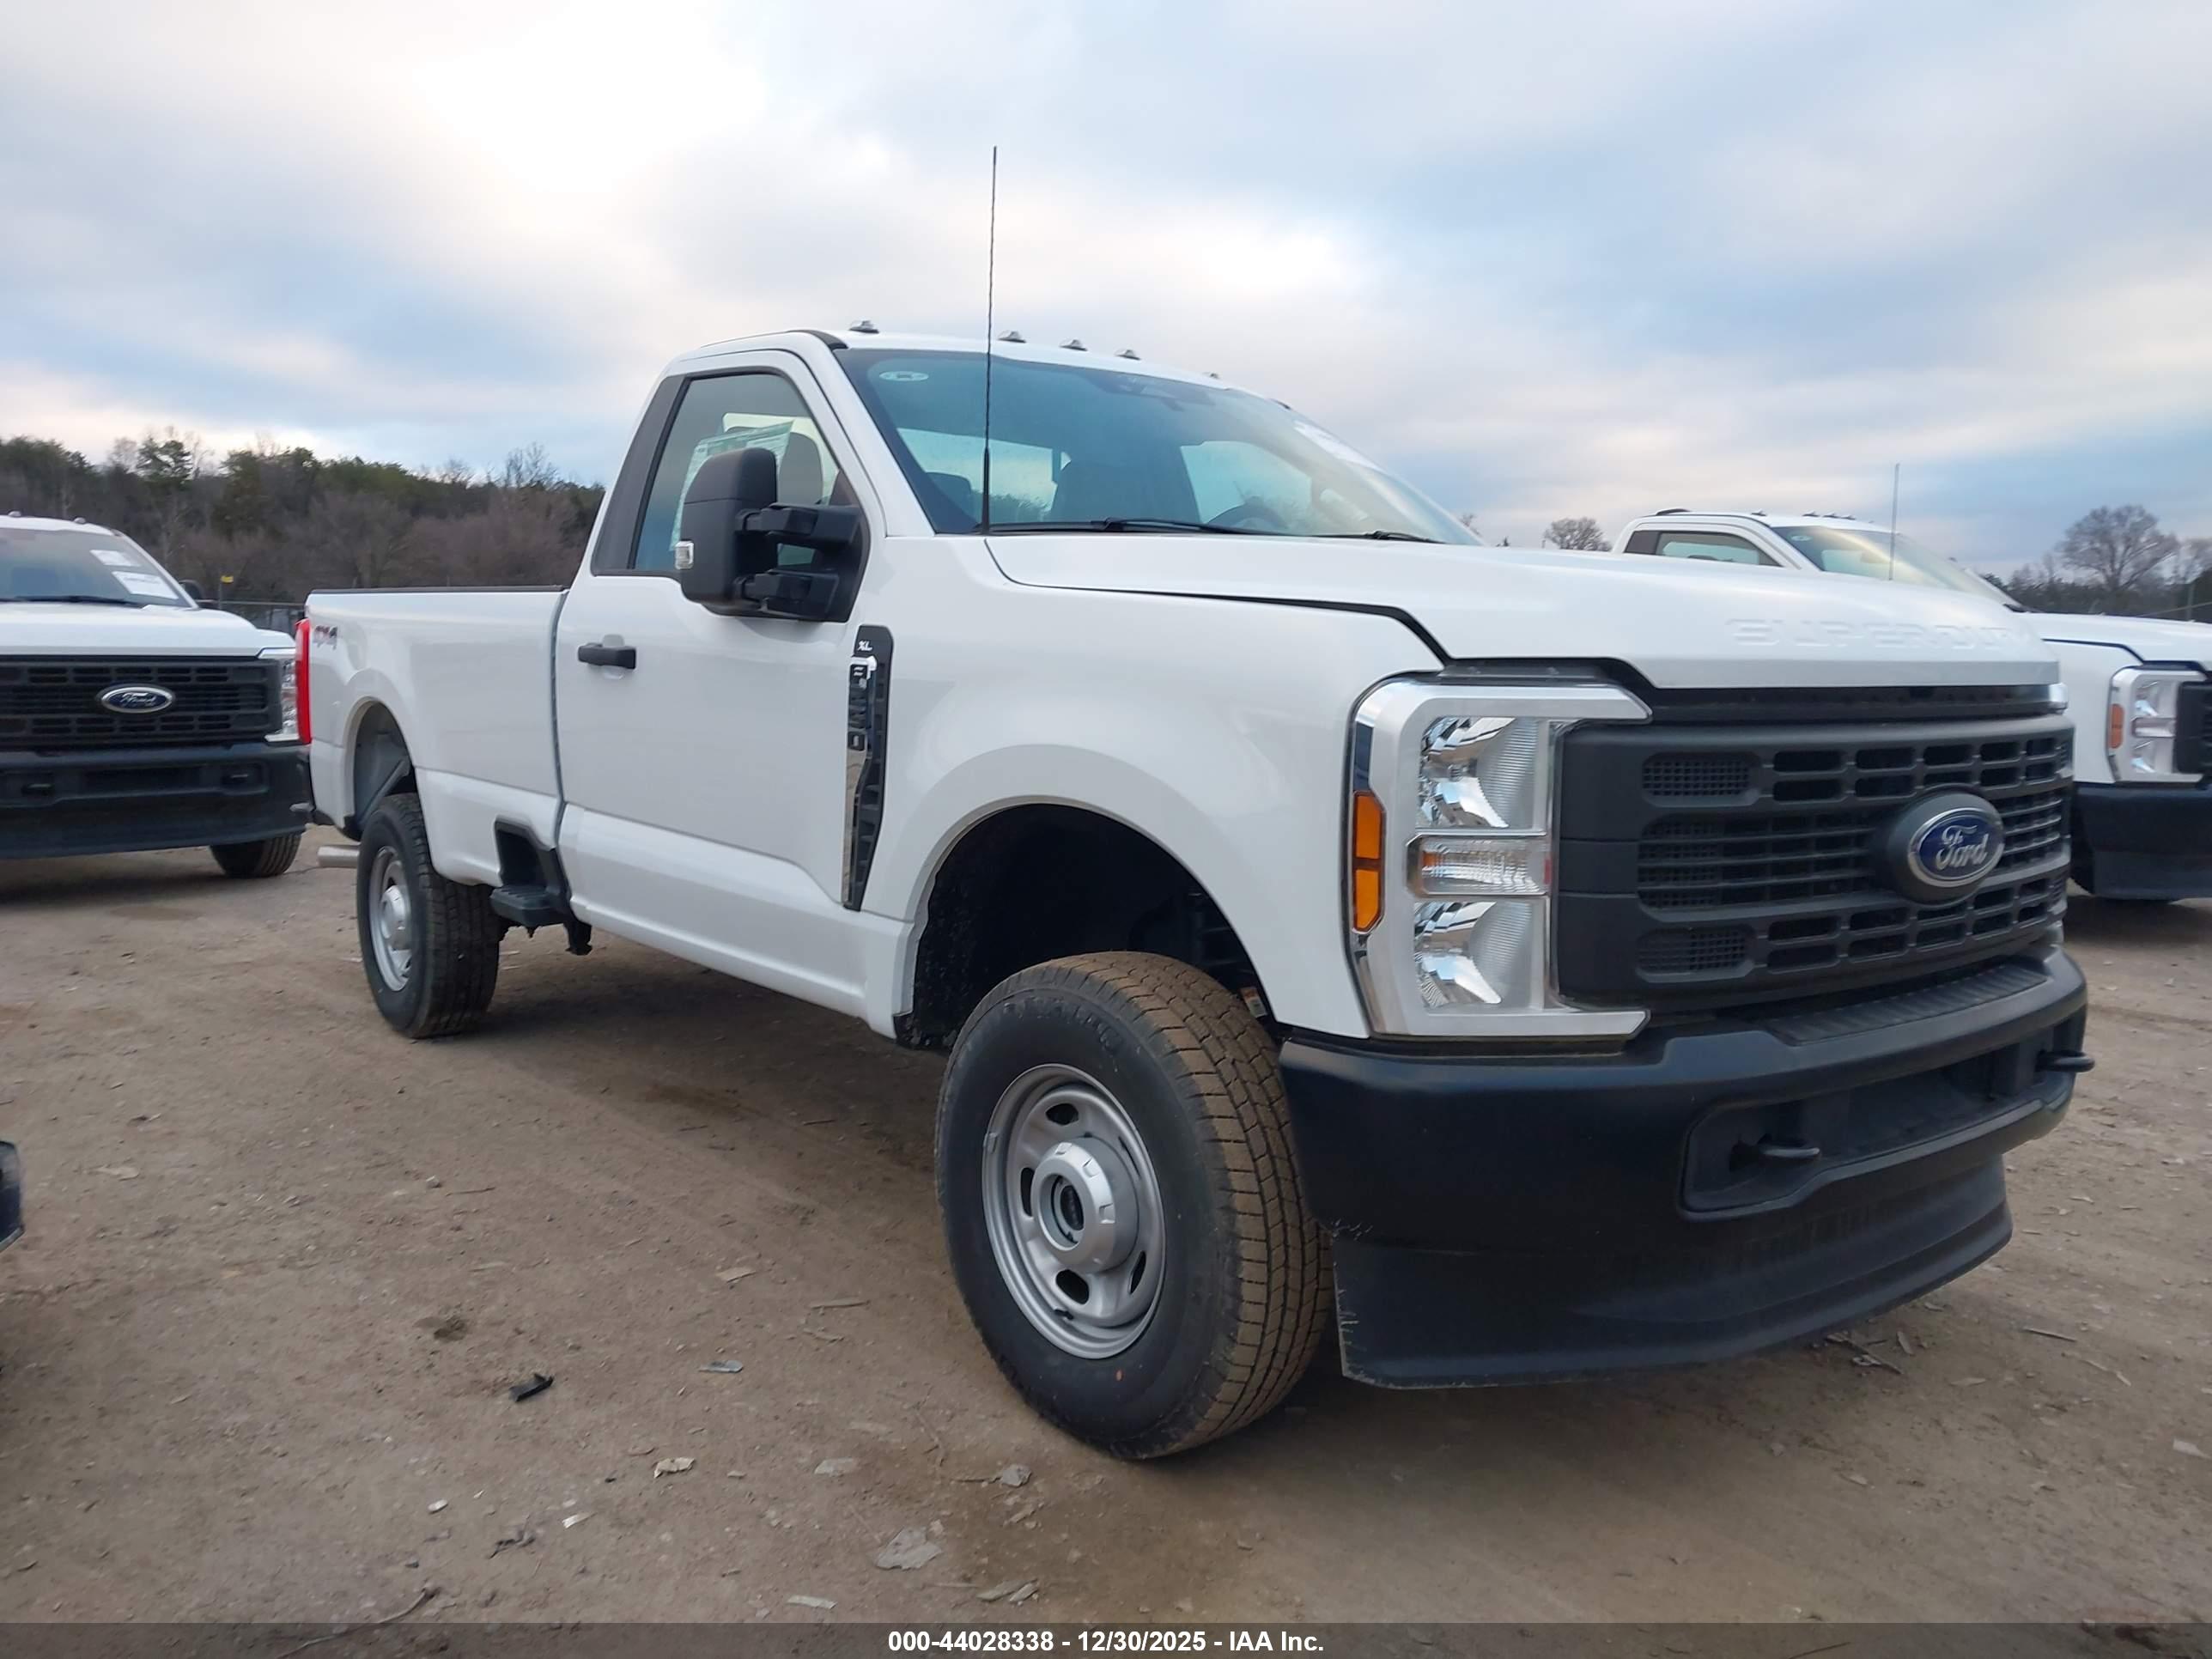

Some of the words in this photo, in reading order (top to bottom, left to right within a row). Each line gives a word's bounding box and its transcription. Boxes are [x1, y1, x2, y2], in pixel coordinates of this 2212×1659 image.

[857, 640, 873, 651] XL
[120, 692, 156, 708] Ford
[1936, 824, 1990, 871] Ford
